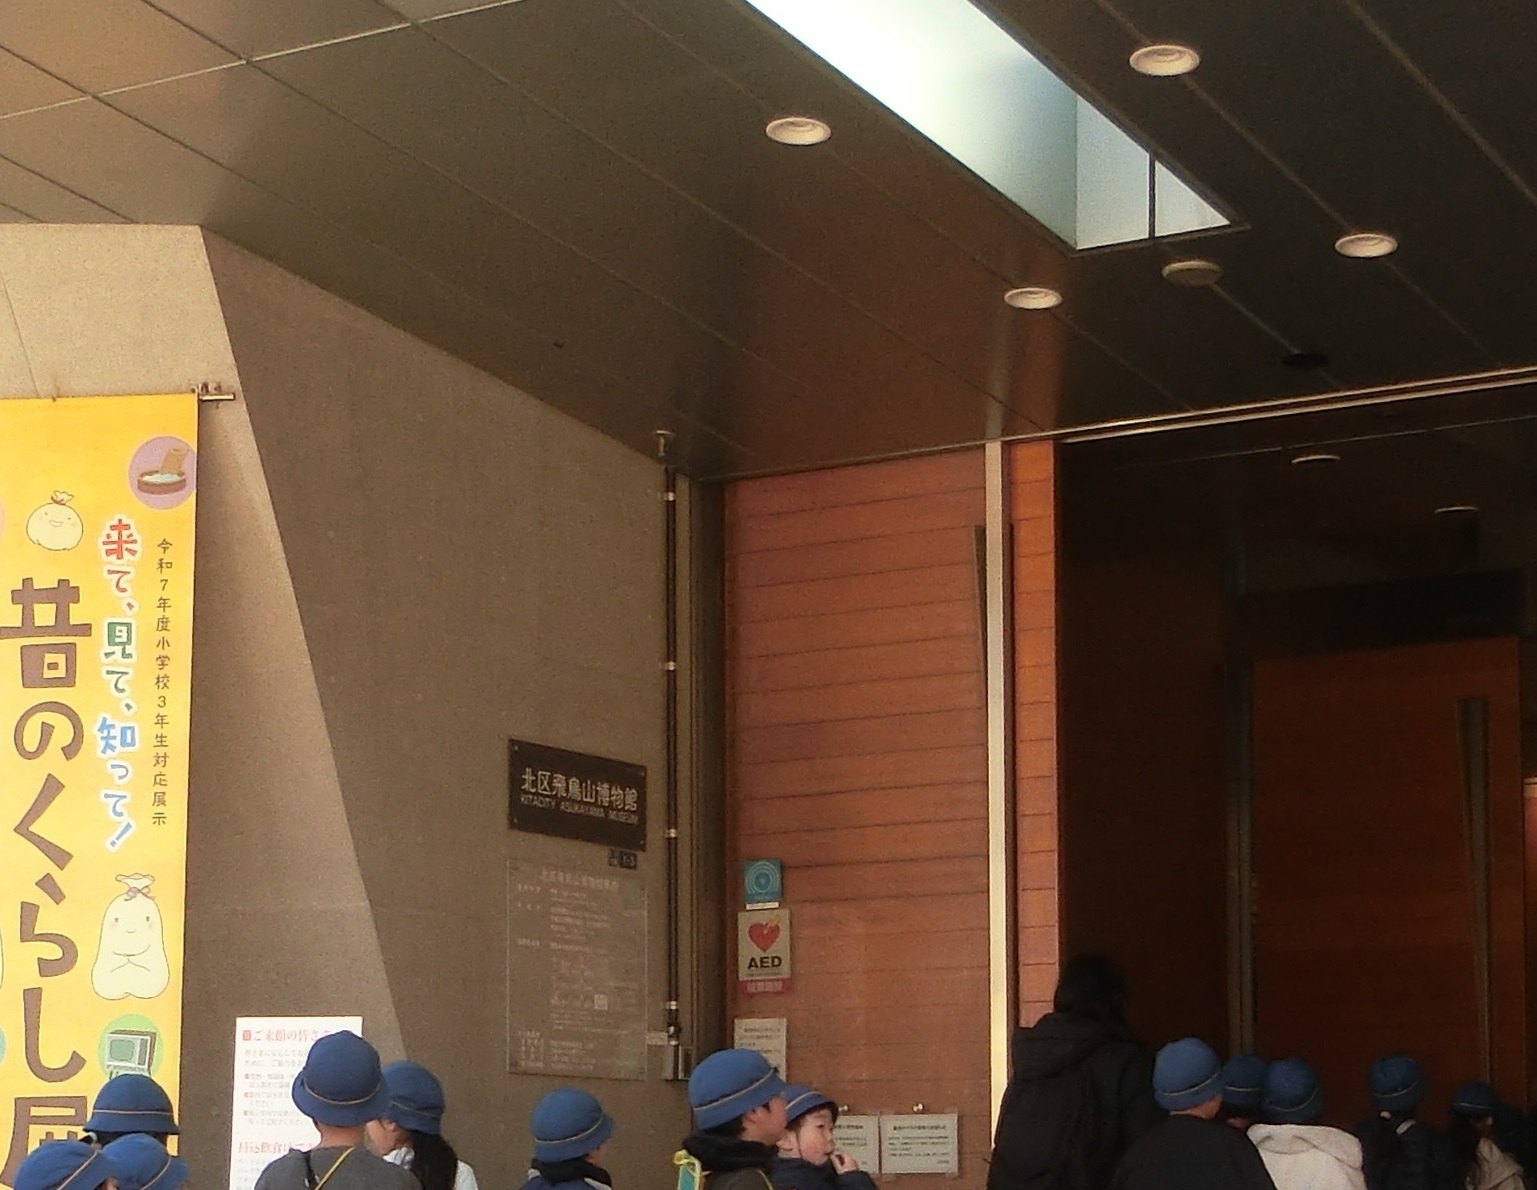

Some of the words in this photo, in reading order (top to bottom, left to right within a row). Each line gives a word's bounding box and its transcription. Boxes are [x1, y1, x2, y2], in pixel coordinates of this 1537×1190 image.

[96, 518, 140, 849] 来て、見て、知って！
[151, 537, 174, 827] 令和7年度小学校3年生対応展示
[521, 767, 638, 811] 北区飛鳥山博物館
[747, 956, 783, 970] AED
